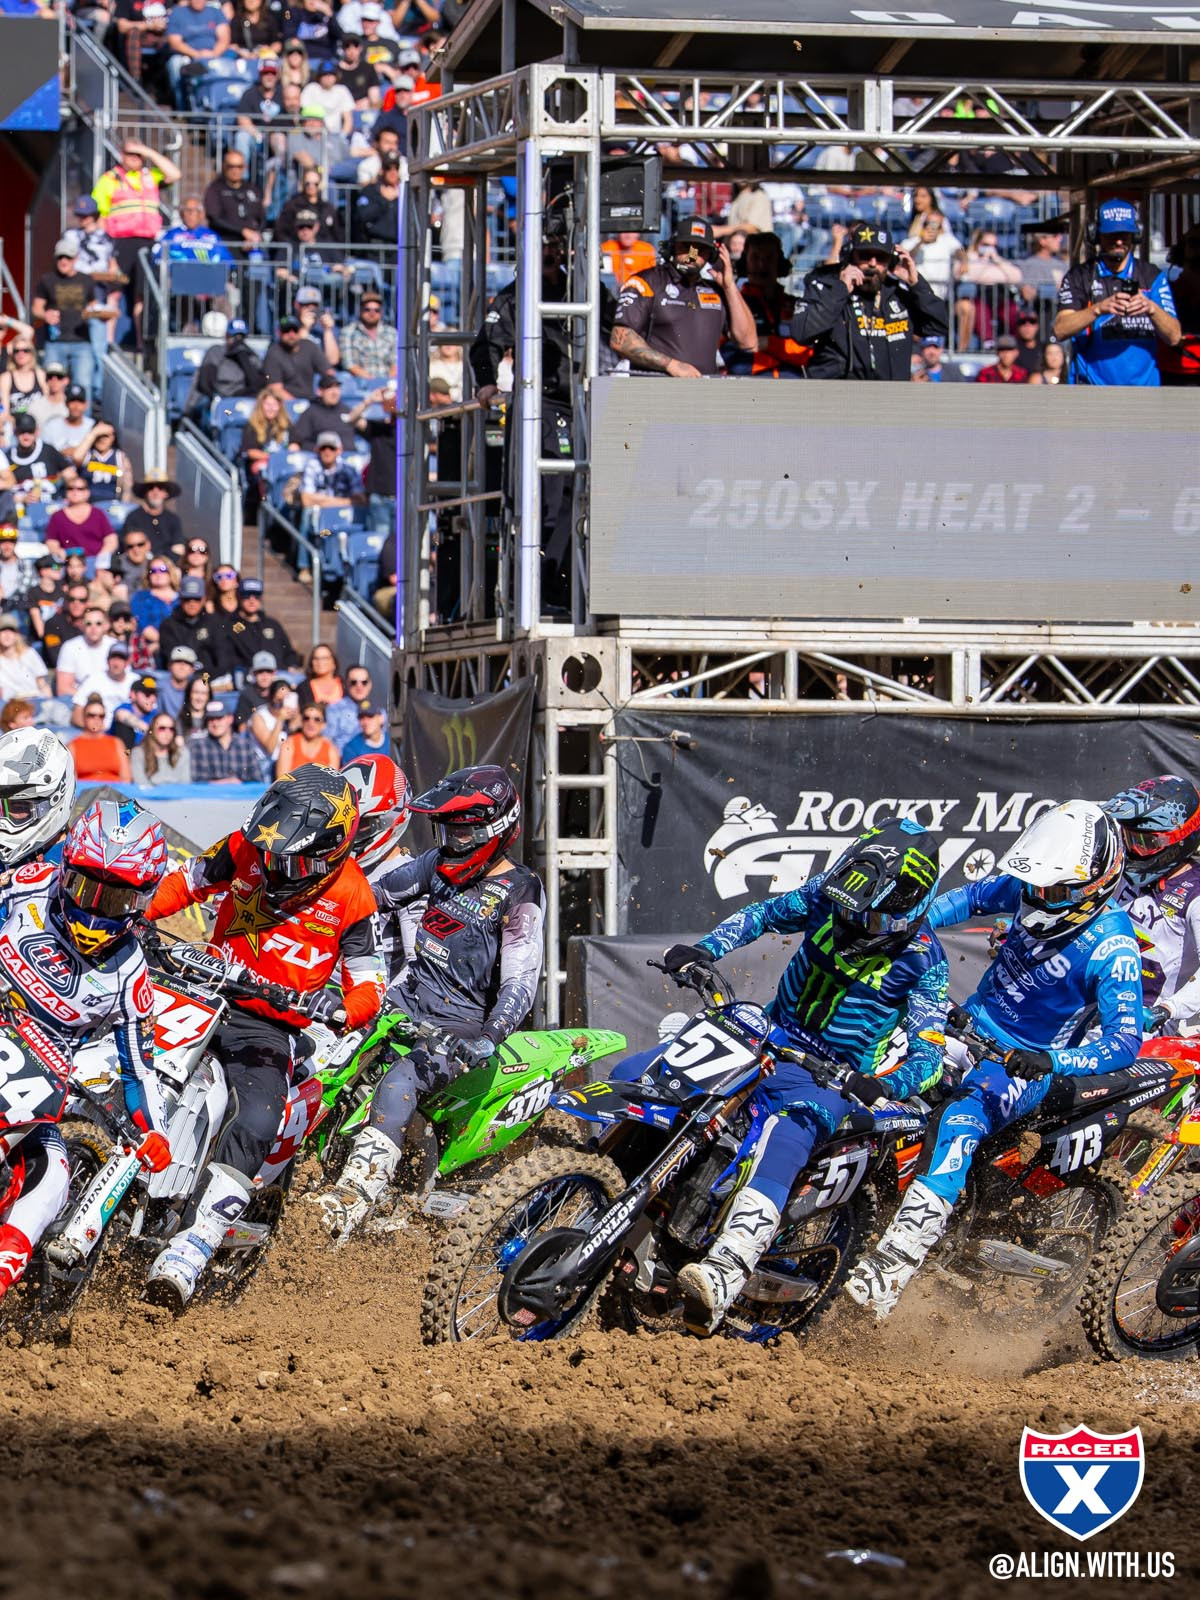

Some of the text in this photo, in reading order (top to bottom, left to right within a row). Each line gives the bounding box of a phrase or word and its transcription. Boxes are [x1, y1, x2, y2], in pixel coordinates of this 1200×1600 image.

[689, 479, 879, 531] 250SX
[897, 481, 1044, 533] HEAT
[1058, 484, 1097, 533] 2
[786, 791, 960, 832] ROCKY
[1079, 813, 1096, 866] synchrony
[262, 933, 334, 969] FLY
[1111, 956, 1140, 982] 473
[0, 942, 74, 1020] GASGAS
[22, 1026, 70, 1079] RENTHAL
[663, 1020, 758, 1083] 57
[504, 1081, 554, 1129] 378
[1082, 1088, 1109, 1099] GUTS
[1128, 1085, 1167, 1107] DUNLOP
[891, 1119, 921, 1129] DUNLOP
[1050, 1123, 1102, 1176] 473
[81, 1157, 121, 1216] DUNLOP
[815, 1148, 869, 1208] 57
[581, 1196, 638, 1260] DUNLOP
